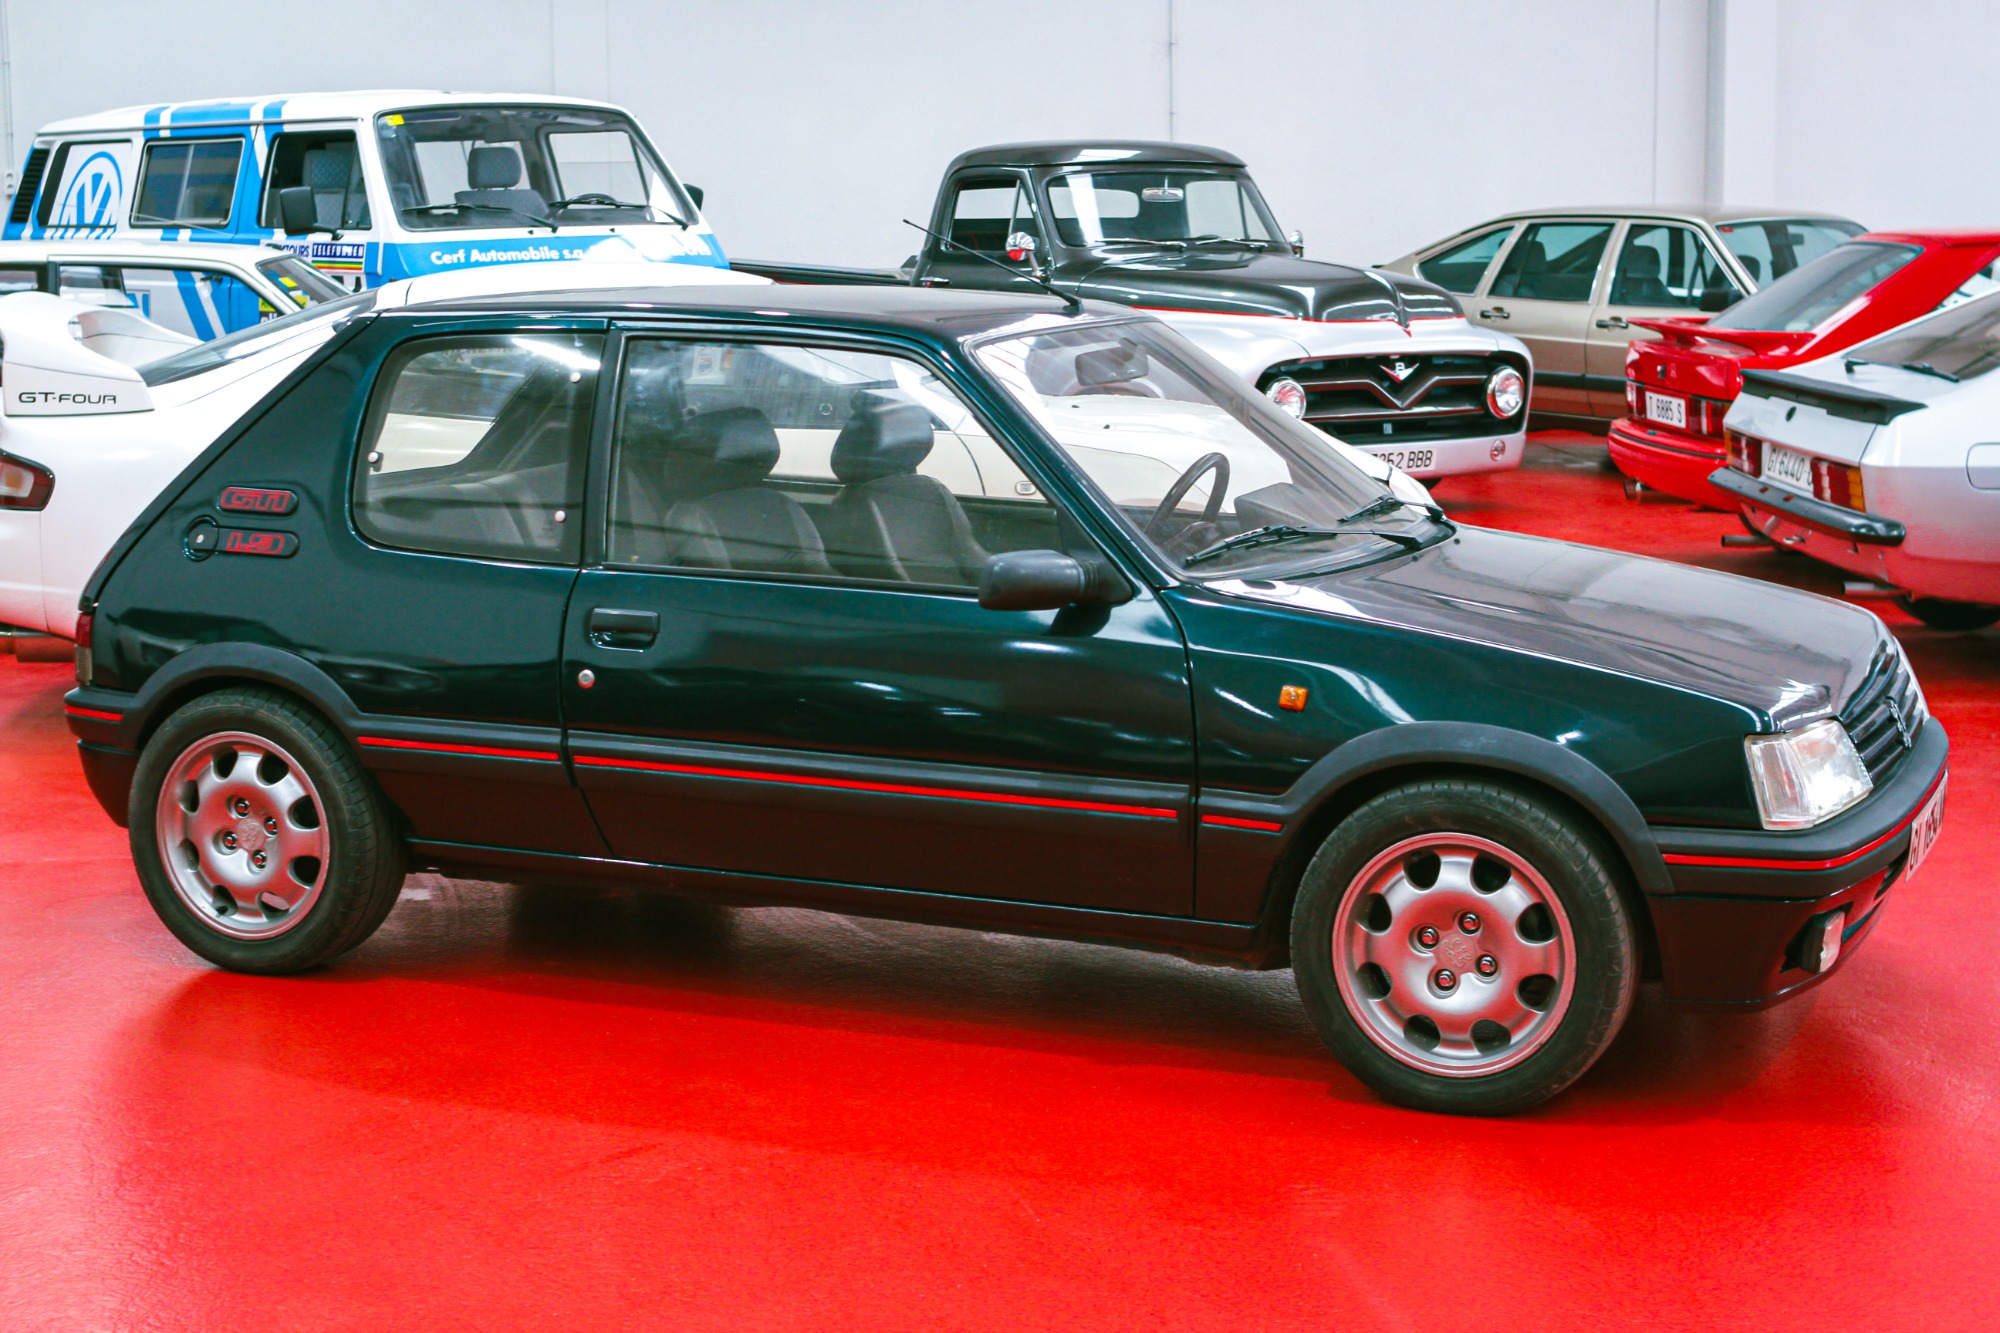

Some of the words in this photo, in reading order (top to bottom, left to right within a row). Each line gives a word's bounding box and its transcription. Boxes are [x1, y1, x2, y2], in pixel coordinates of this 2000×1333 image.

[430, 250, 466, 265] Cerf
[470, 246, 560, 262] Automobile
[18, 392, 117, 404] GT-FOUR
[1407, 450, 1433, 468] BBB
[220, 488, 291, 512] GTI
